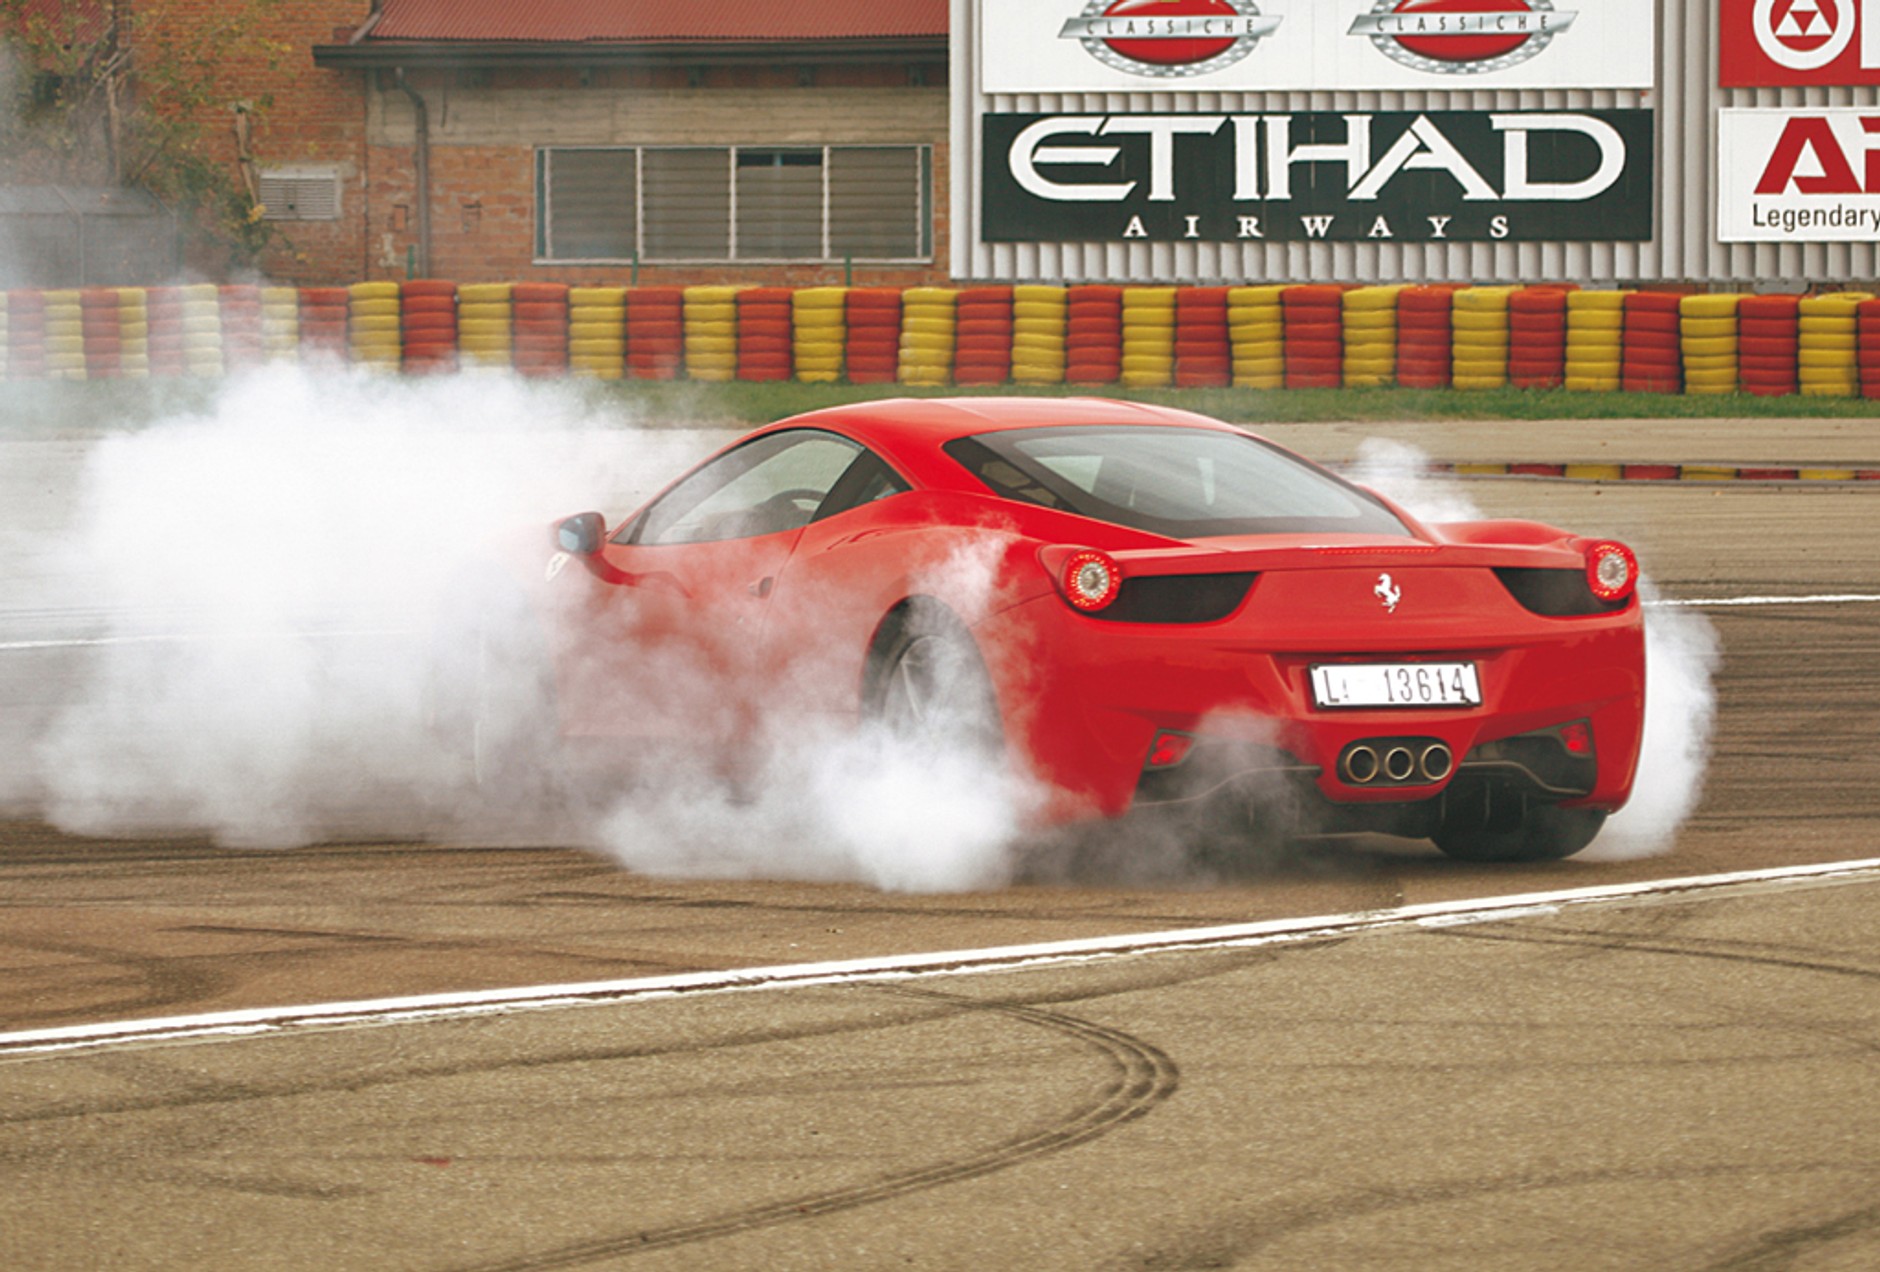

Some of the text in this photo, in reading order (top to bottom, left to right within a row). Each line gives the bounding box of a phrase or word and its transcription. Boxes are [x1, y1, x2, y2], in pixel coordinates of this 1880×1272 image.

[1086, 18, 1254, 35] CLASSICHE
[1376, 14, 1548, 32] CLASSICHE
[1008, 113, 1627, 201] ETIHAD
[1123, 215, 1509, 238] AIRWAYS
[1752, 203, 1880, 233] Legendary
[1383, 667, 1473, 702] 13614
